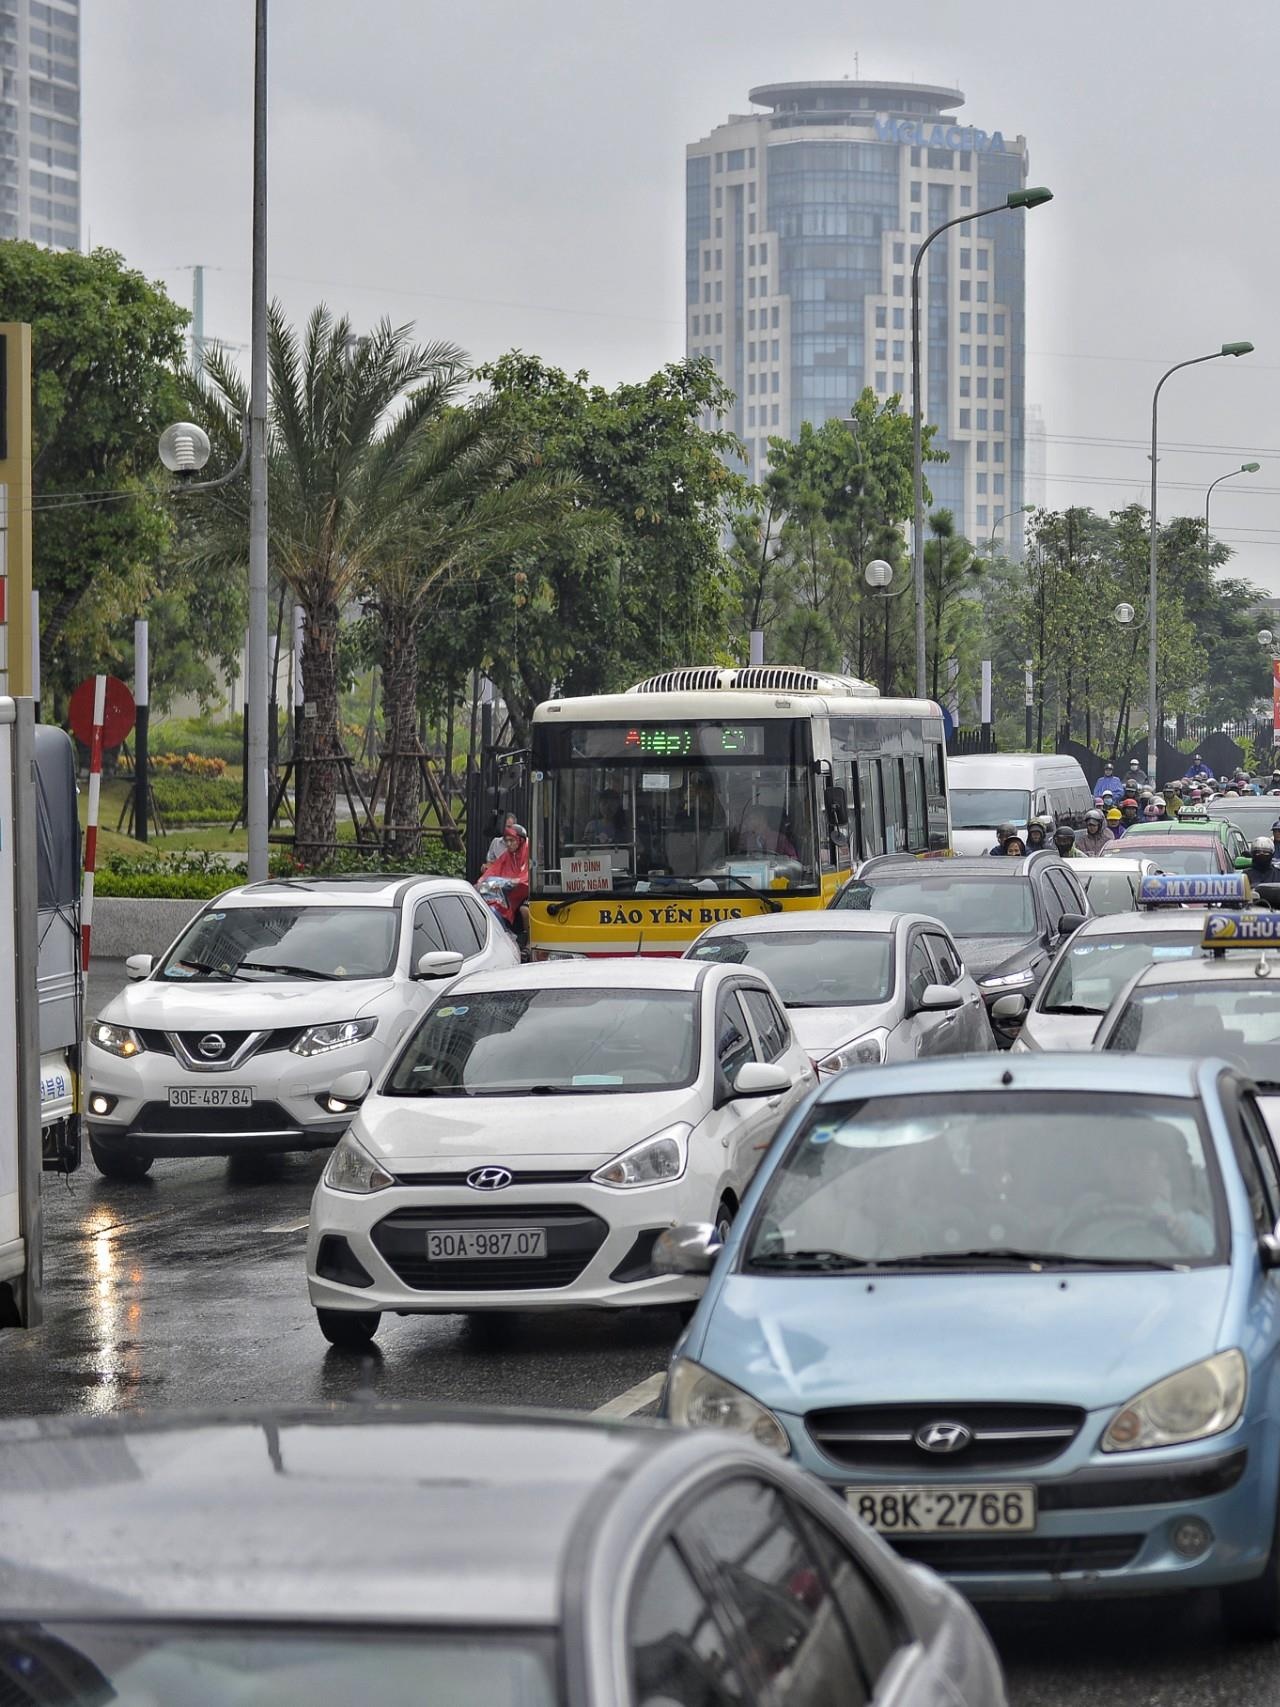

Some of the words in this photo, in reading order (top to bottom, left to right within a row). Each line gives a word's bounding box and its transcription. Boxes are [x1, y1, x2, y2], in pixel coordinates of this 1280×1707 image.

[875, 118, 1006, 153] VIGLACERA
[1181, 806, 1203, 814] TAXI
[599, 905, 643, 925] BẢO
[649, 904, 692, 923] YẾN
[699, 908, 742, 923] BUS
[171, 1090, 248, 1105] 30E-487.84
[430, 1233, 542, 1256] 30A-987.07
[858, 1492, 1024, 1528] 88K-2766
